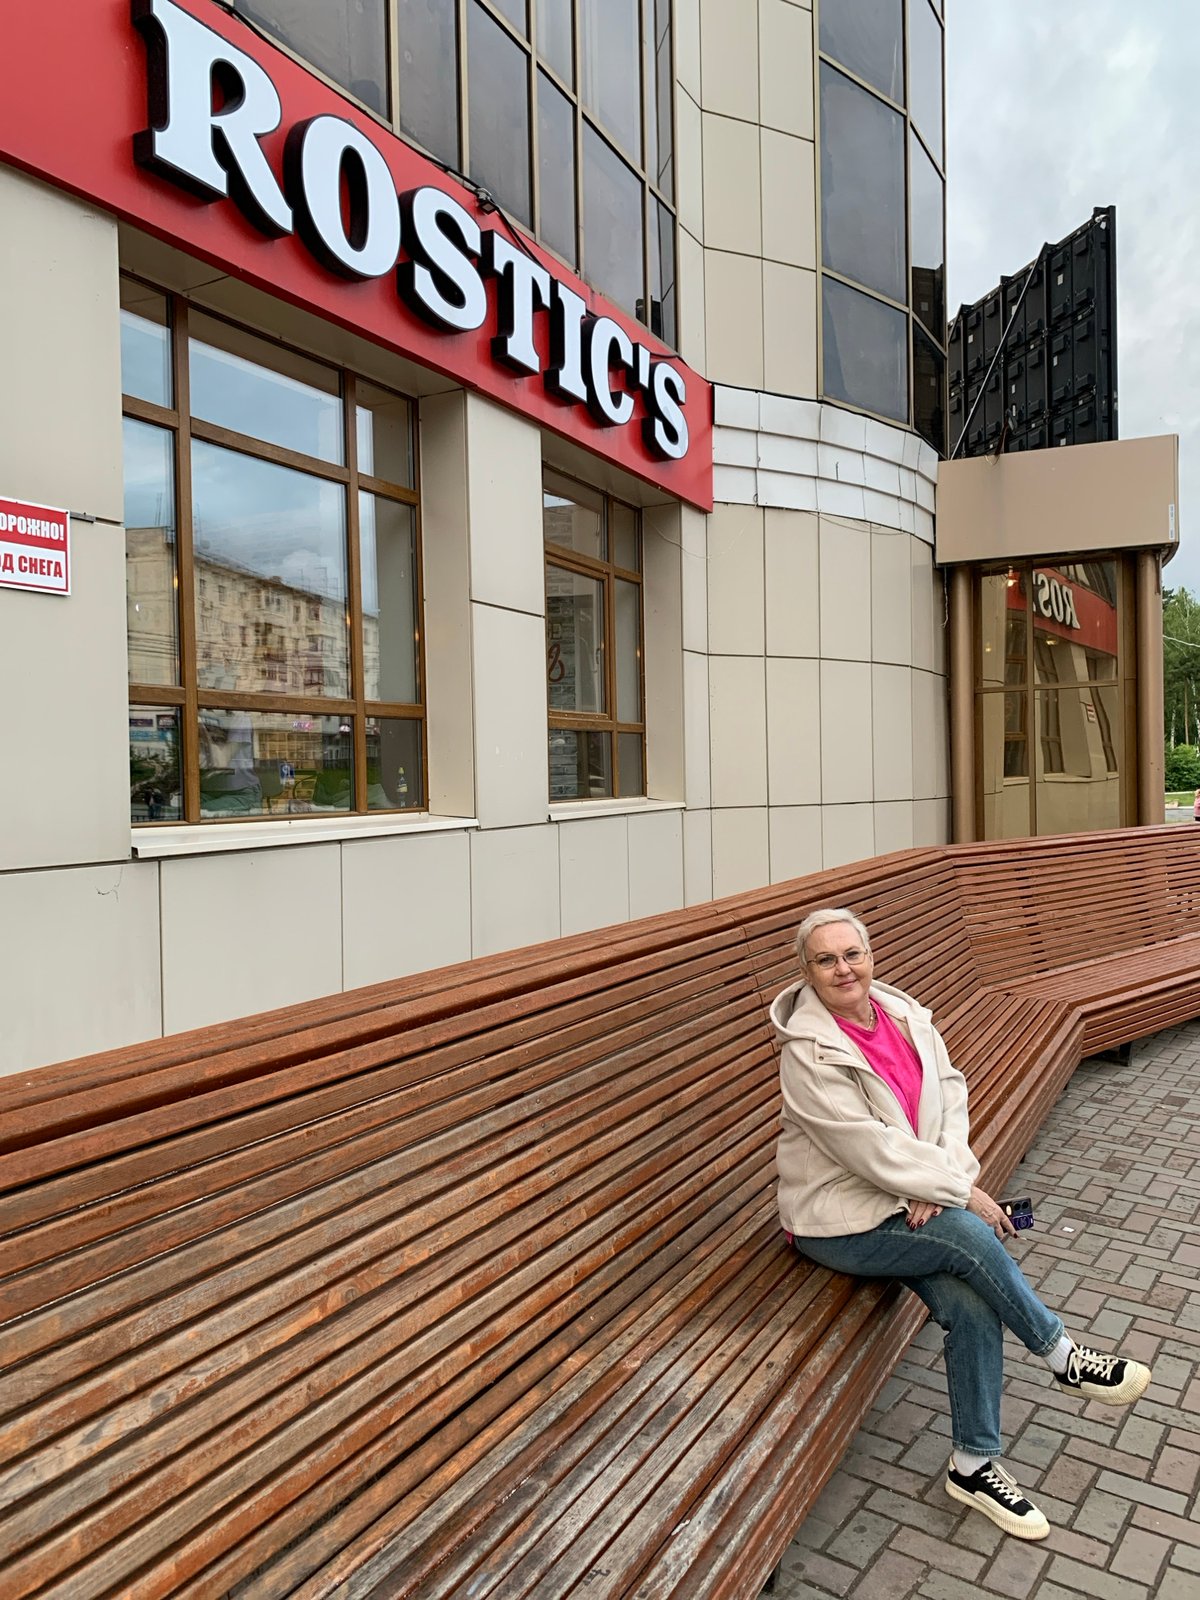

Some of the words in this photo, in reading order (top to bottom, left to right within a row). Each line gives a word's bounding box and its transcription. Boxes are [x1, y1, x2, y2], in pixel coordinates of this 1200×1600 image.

[149, 0, 689, 459] ROSTIC'S
[0, 512, 64, 541] ОРОЖНО!
[0, 553, 14, 573] Д
[18, 555, 63, 578] СНЕГА
